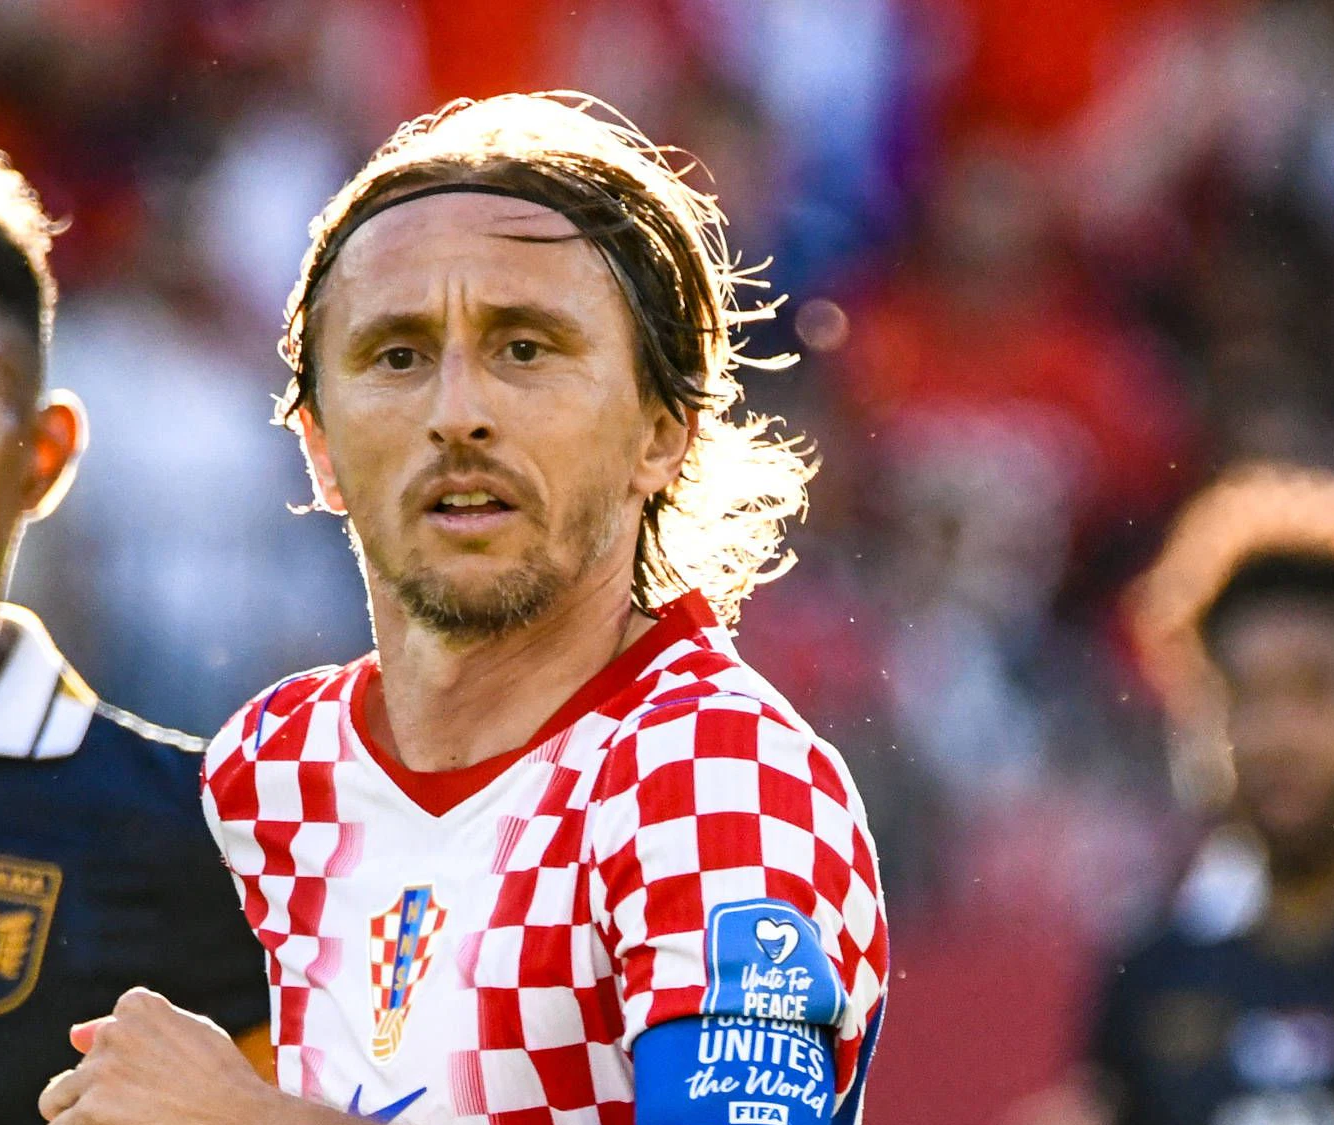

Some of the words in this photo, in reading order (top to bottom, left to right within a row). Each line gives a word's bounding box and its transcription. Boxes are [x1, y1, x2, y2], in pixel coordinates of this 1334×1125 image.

[741, 962, 786, 992] Unite
[785, 966, 814, 993] For
[744, 992, 808, 1020] PEACE
[698, 1029, 824, 1082] UNITES
[685, 1066, 740, 1100] the
[745, 1066, 828, 1119] World
[736, 1106, 783, 1121] FIFA
